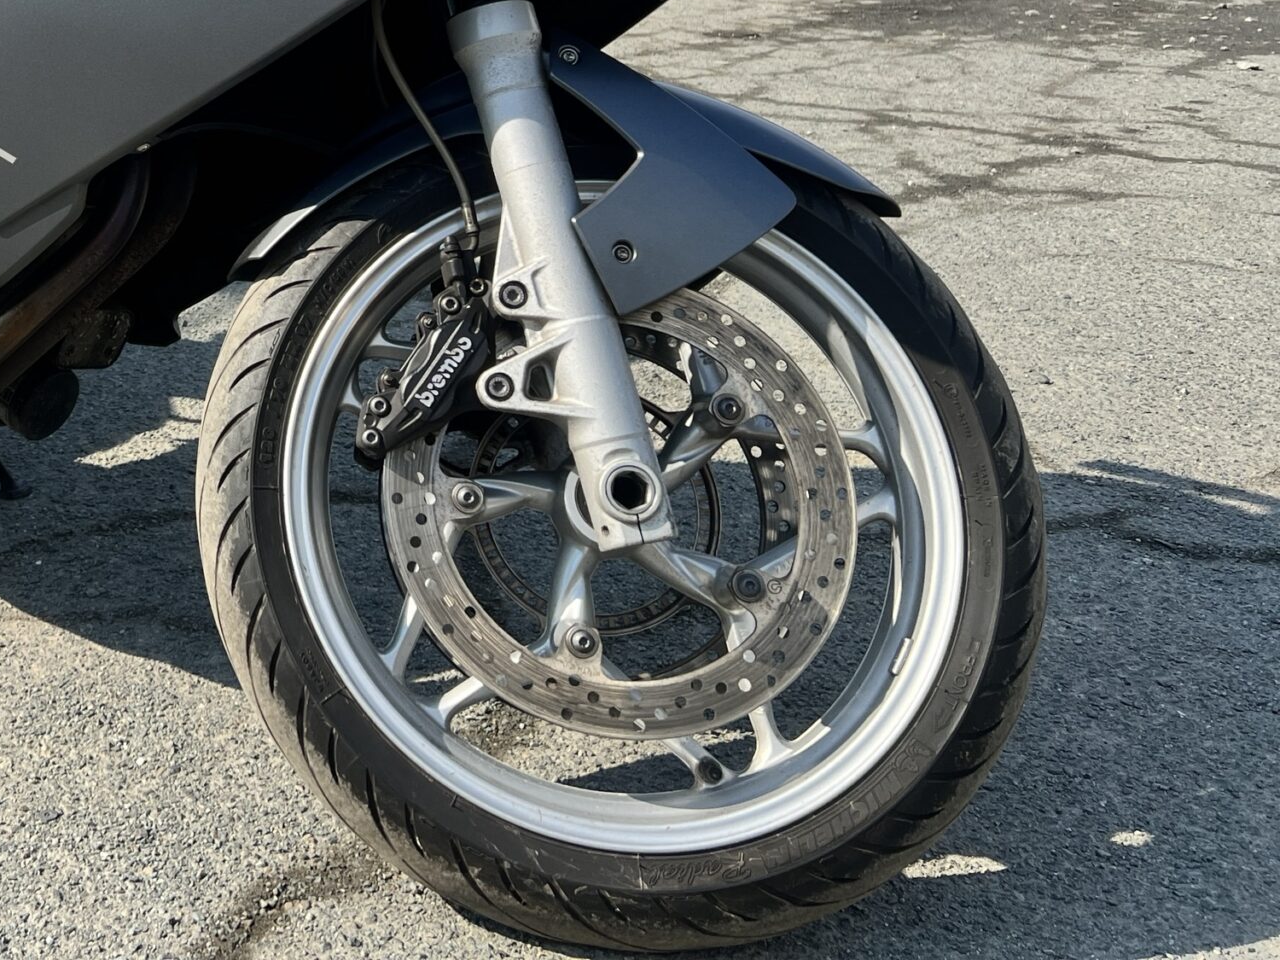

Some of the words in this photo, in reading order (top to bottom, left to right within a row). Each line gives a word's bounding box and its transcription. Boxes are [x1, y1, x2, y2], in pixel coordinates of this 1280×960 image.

[414, 336, 473, 408] brembo
[945, 654, 977, 711] FRONT
[762, 771, 905, 868] MICHELIN
